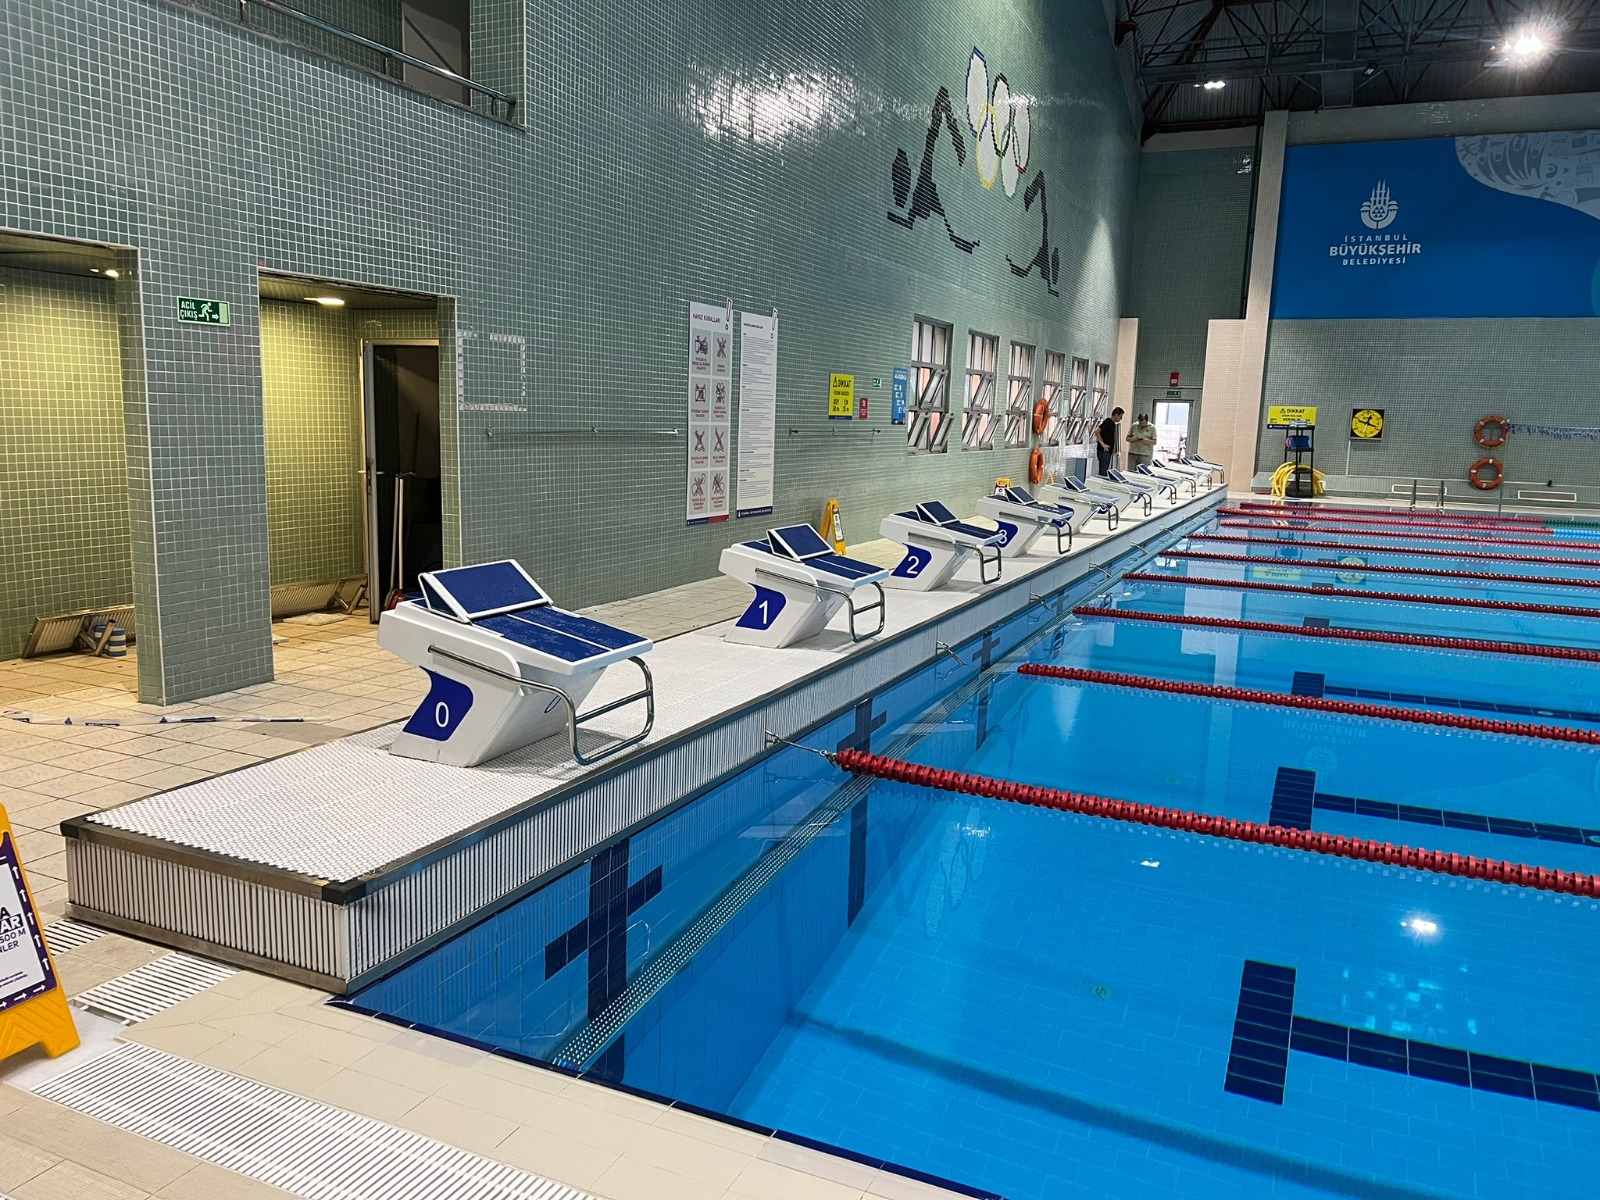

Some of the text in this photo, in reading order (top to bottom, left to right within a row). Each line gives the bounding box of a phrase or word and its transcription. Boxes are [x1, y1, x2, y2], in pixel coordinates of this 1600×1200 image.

[1344, 234, 1408, 242] İSTANBUL
[1329, 241, 1422, 257] BÜYÜKŞEHİR
[1342, 256, 1406, 266] BELEDİYESİ
[181, 299, 196, 310] ACİL
[180, 309, 198, 321] ÇIKIŞ
[906, 555, 920, 575] 2
[758, 599, 768, 625] 1
[435, 701, 450, 728] 0
[18, 928, 26, 937] M
